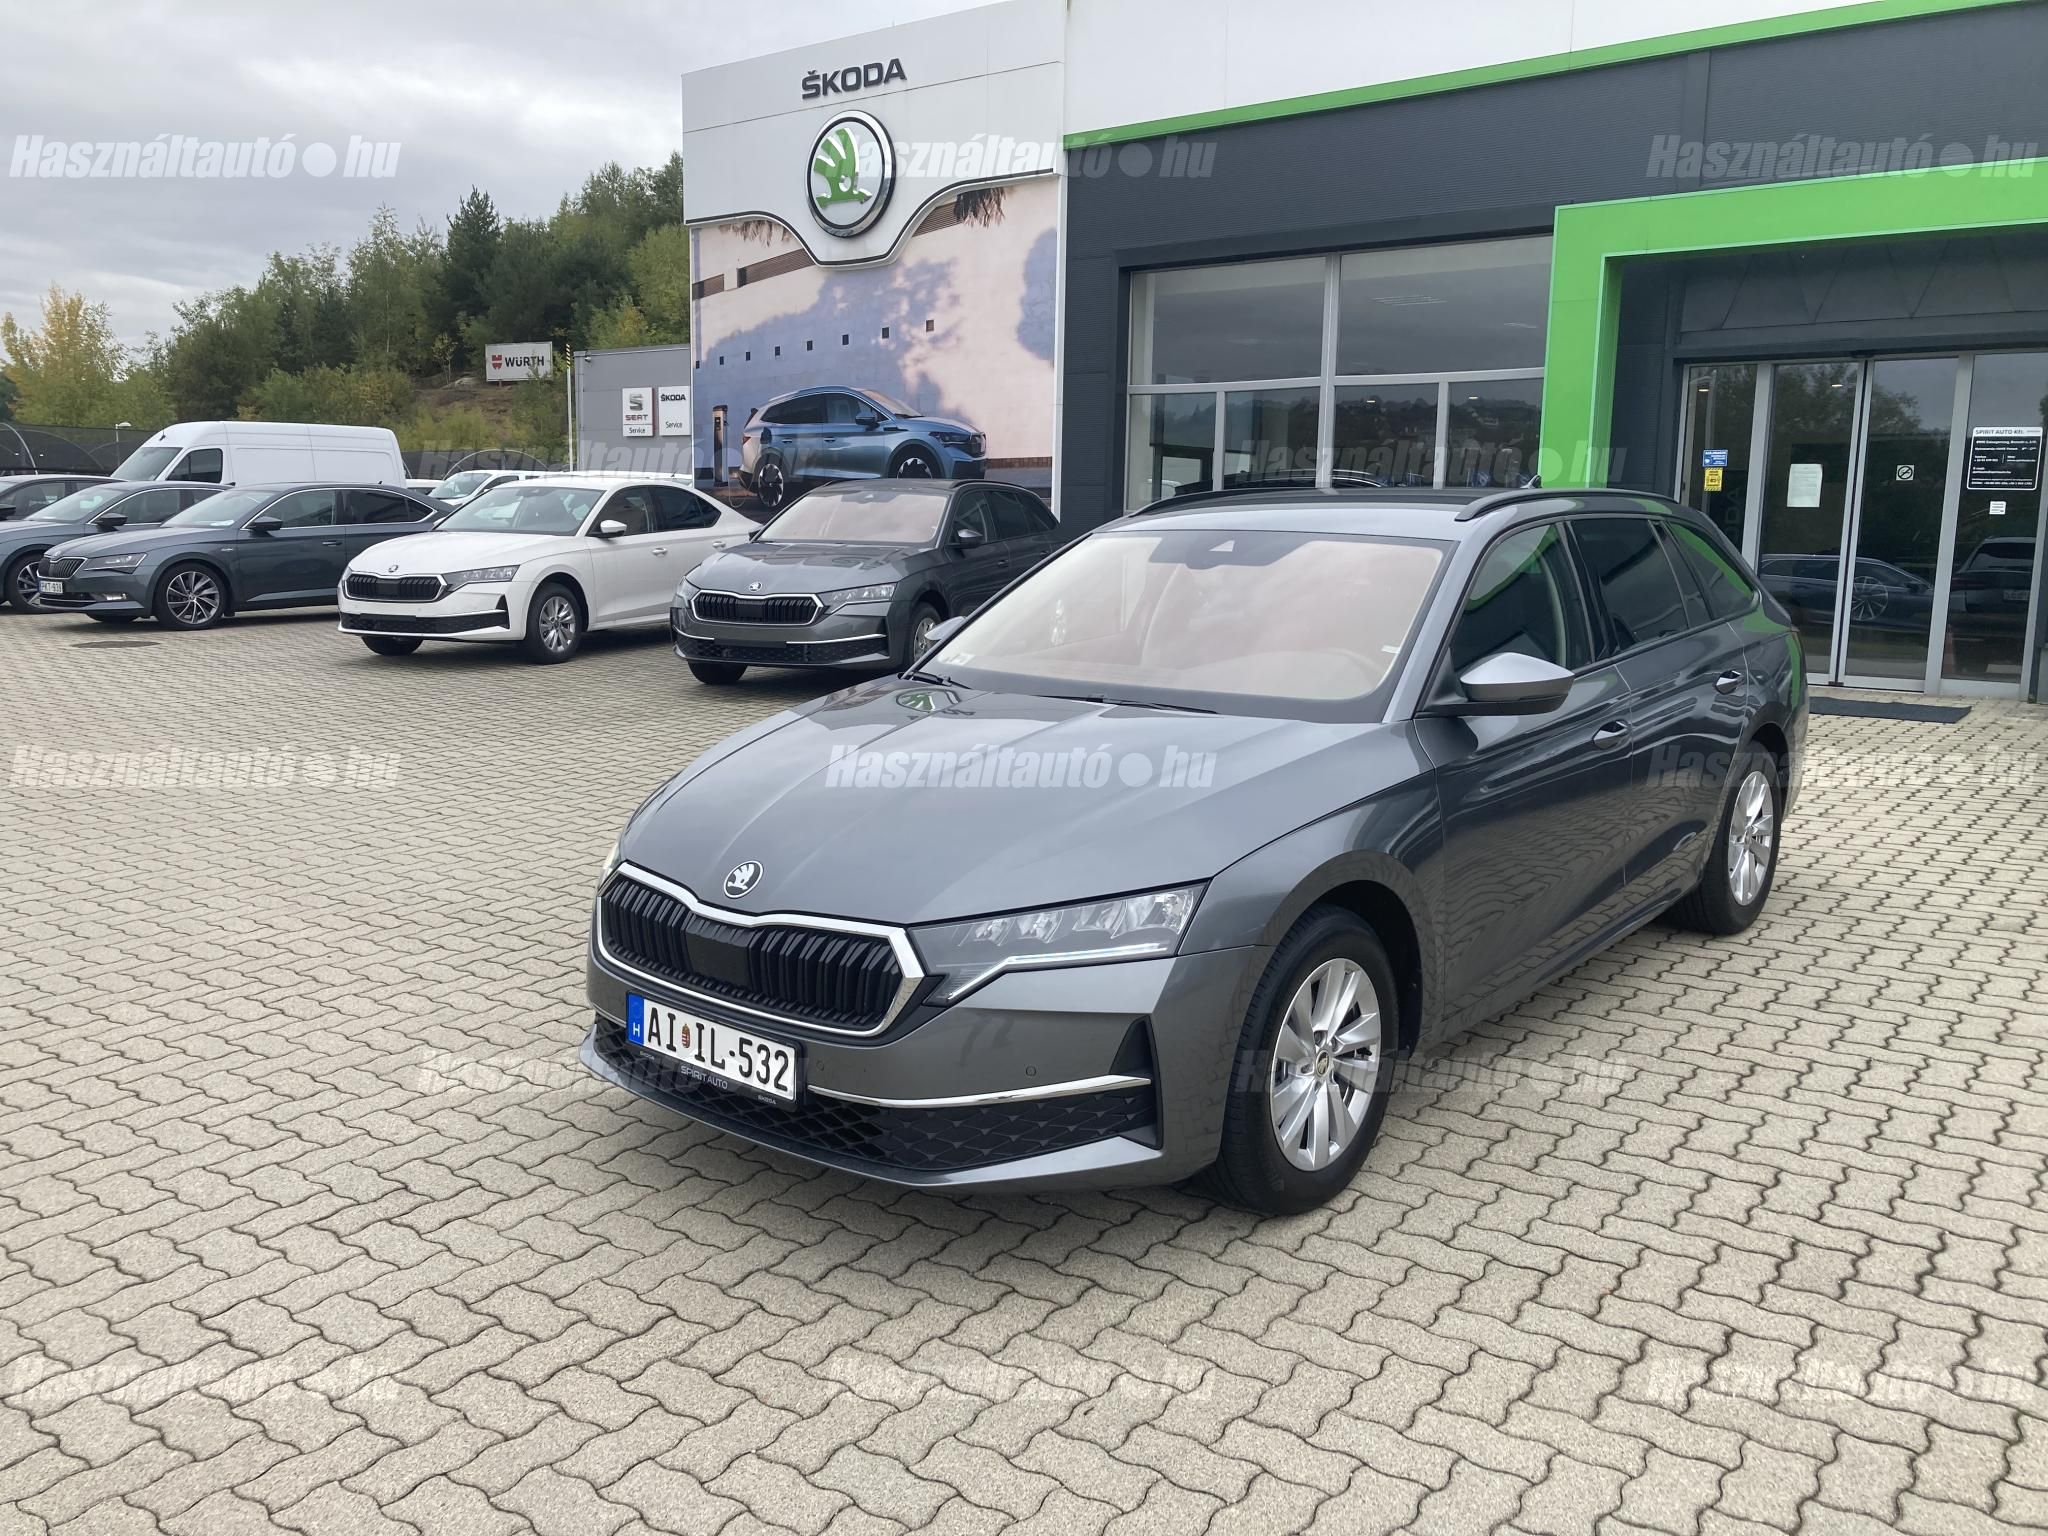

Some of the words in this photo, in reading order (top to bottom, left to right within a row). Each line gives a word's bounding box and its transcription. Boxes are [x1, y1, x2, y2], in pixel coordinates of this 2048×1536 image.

[801, 58, 907, 100] ŠKODA
[504, 355, 545, 368] WÜRTH
[660, 393, 687, 402] ŠKODA
[665, 420, 684, 429] Service
[628, 427, 647, 435] Service
[632, 1022, 641, 1038] H
